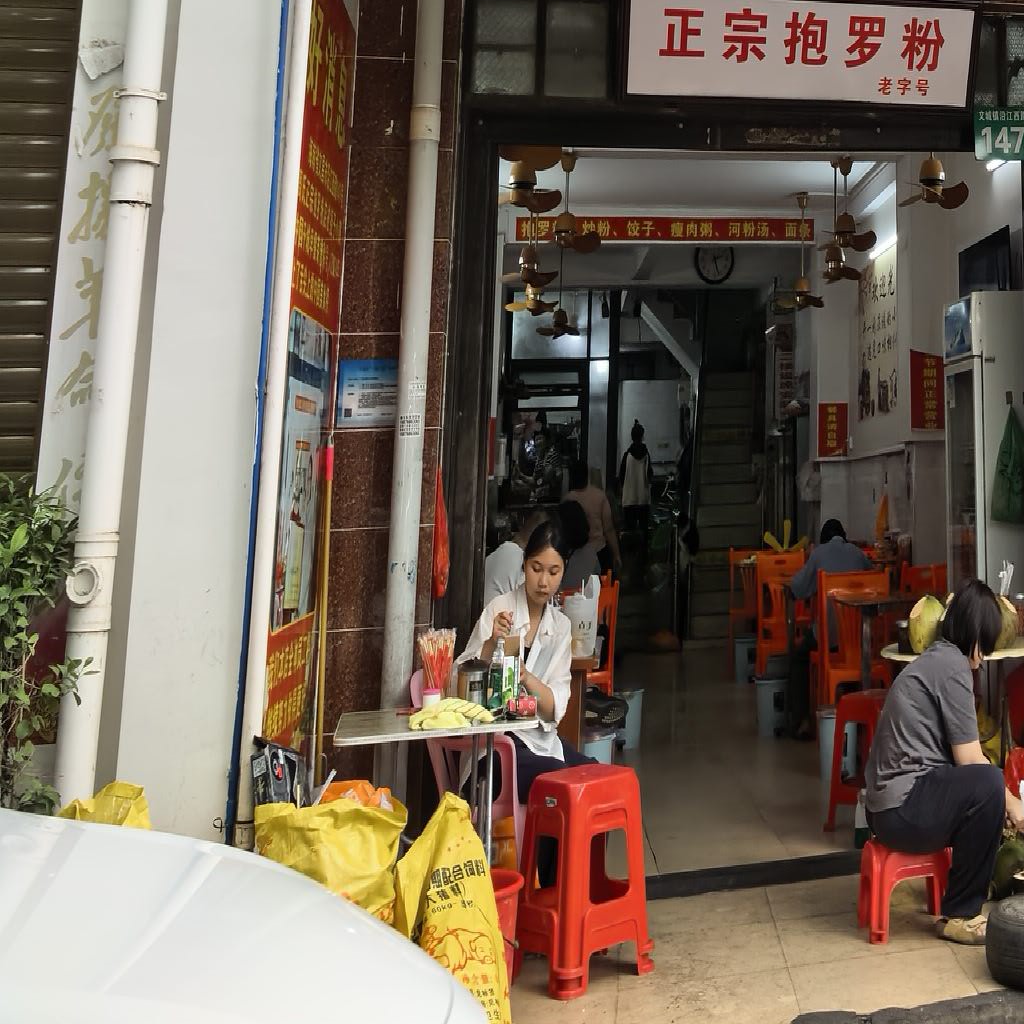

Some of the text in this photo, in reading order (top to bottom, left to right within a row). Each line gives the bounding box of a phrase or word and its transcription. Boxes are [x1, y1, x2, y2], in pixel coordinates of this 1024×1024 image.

[658, 7, 945, 73] 正宗抱罗粉
[878, 76, 931, 97] 老字号
[981, 126, 1024, 153] 147
